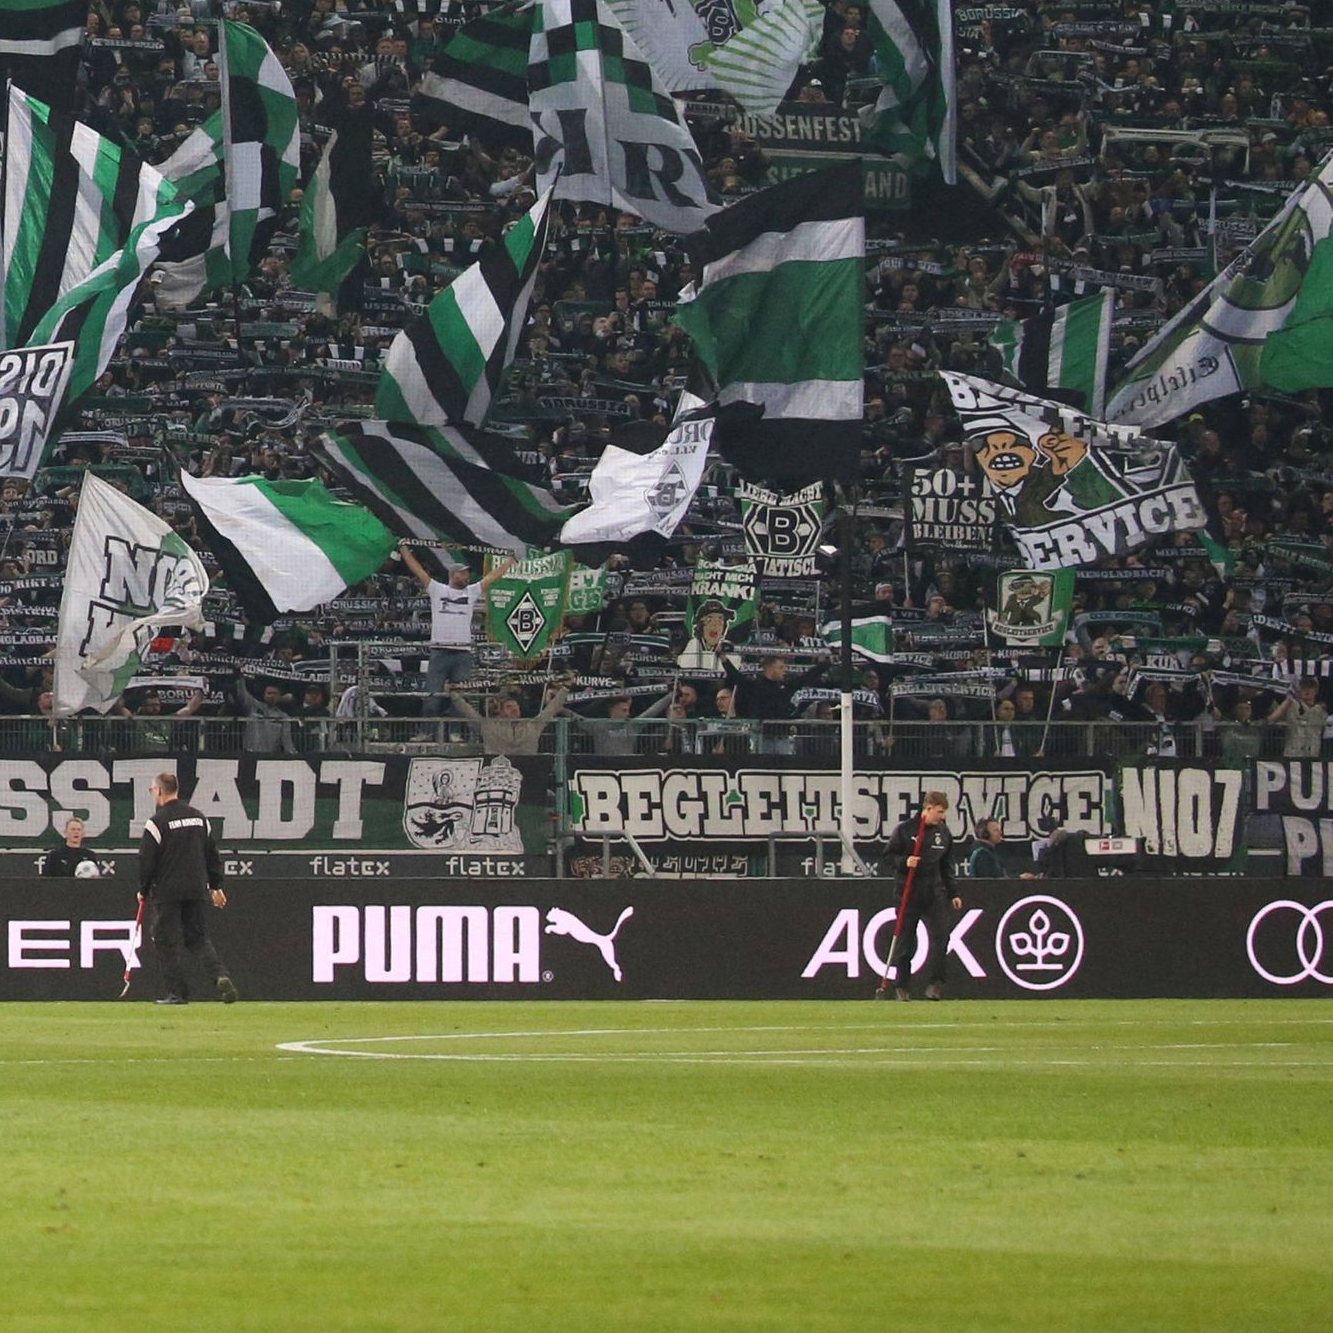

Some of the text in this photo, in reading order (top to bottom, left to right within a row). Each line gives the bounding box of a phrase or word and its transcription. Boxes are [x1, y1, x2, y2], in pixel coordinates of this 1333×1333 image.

[957, 8, 1021, 20] BORUSSIA
[911, 498, 995, 523] MUSS
[768, 508, 801, 556] B
[911, 523, 994, 541] BLEIBEN!
[1016, 485, 1207, 570] SERVICE
[27, 550, 58, 566] ORD
[725, 572, 755, 584] MICH
[691, 582, 757, 602] KRANK!
[239, 663, 358, 684] MÖNCHENGLADBCH
[1256, 761, 1333, 811] PU
[576, 770, 1106, 843] BEGLEITSERVICE
[309, 856, 390, 876] flatex
[444, 855, 526, 876] flatex
[312, 905, 541, 983] PUMA
